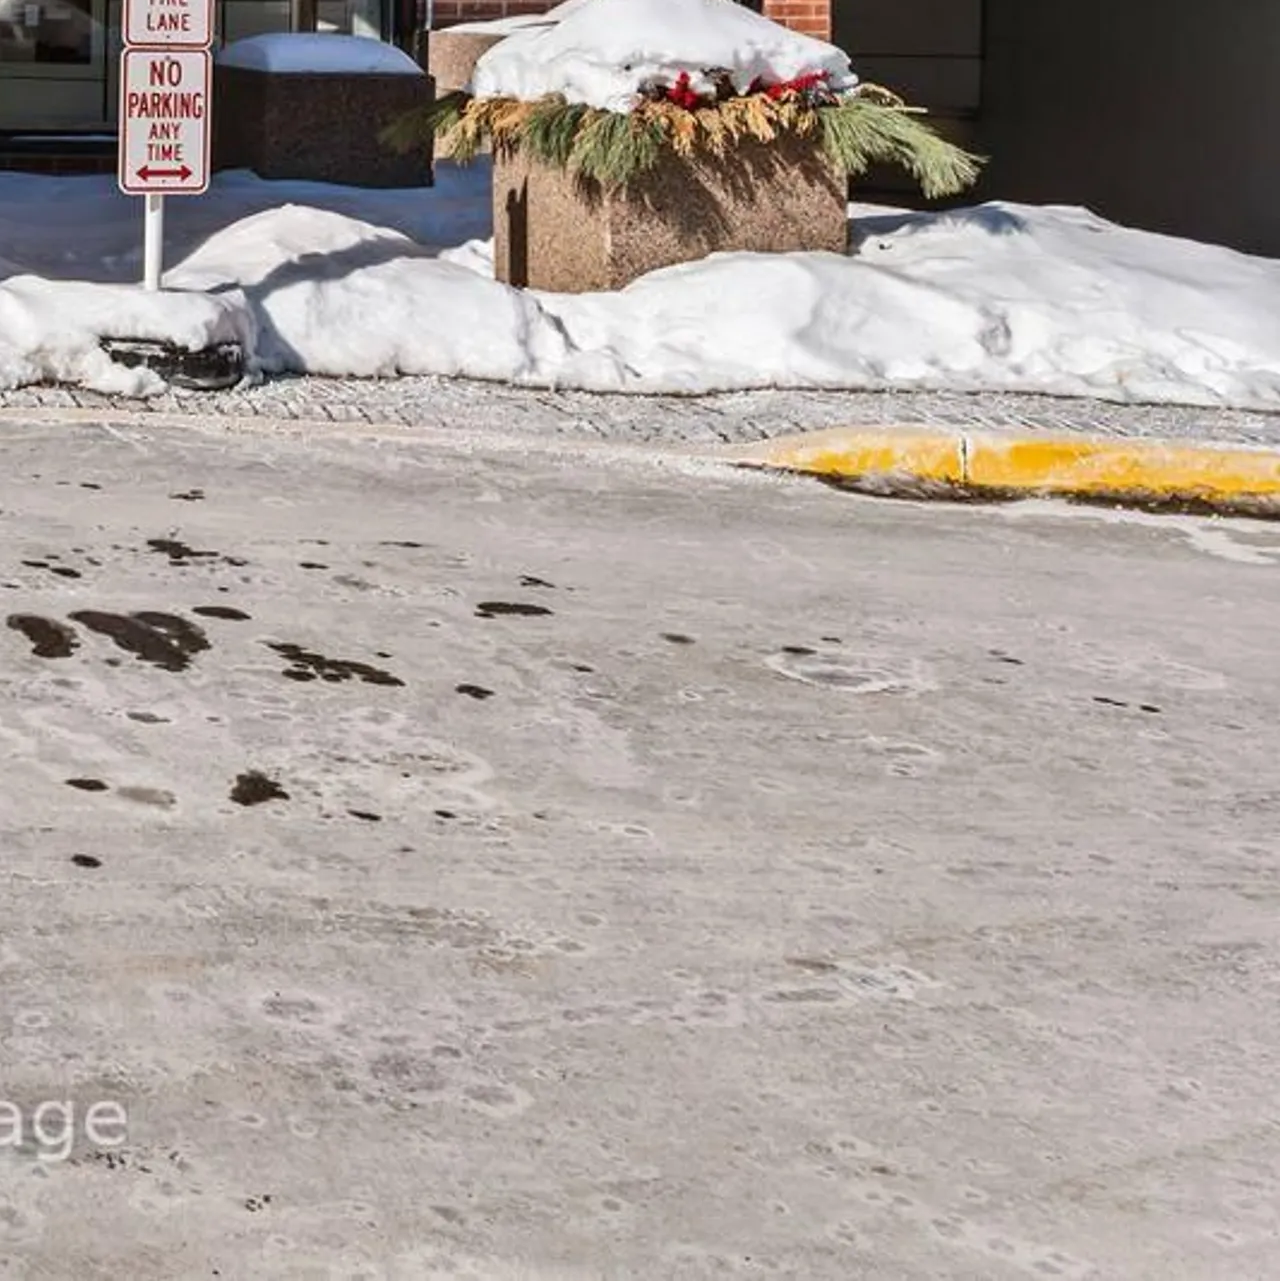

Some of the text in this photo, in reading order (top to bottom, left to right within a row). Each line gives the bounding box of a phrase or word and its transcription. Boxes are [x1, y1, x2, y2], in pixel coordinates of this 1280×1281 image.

[146, 13, 191, 32] LANE
[149, 60, 183, 87] NO
[127, 92, 203, 119] PARKING
[149, 122, 182, 140] ANY
[147, 143, 184, 162] TIME
